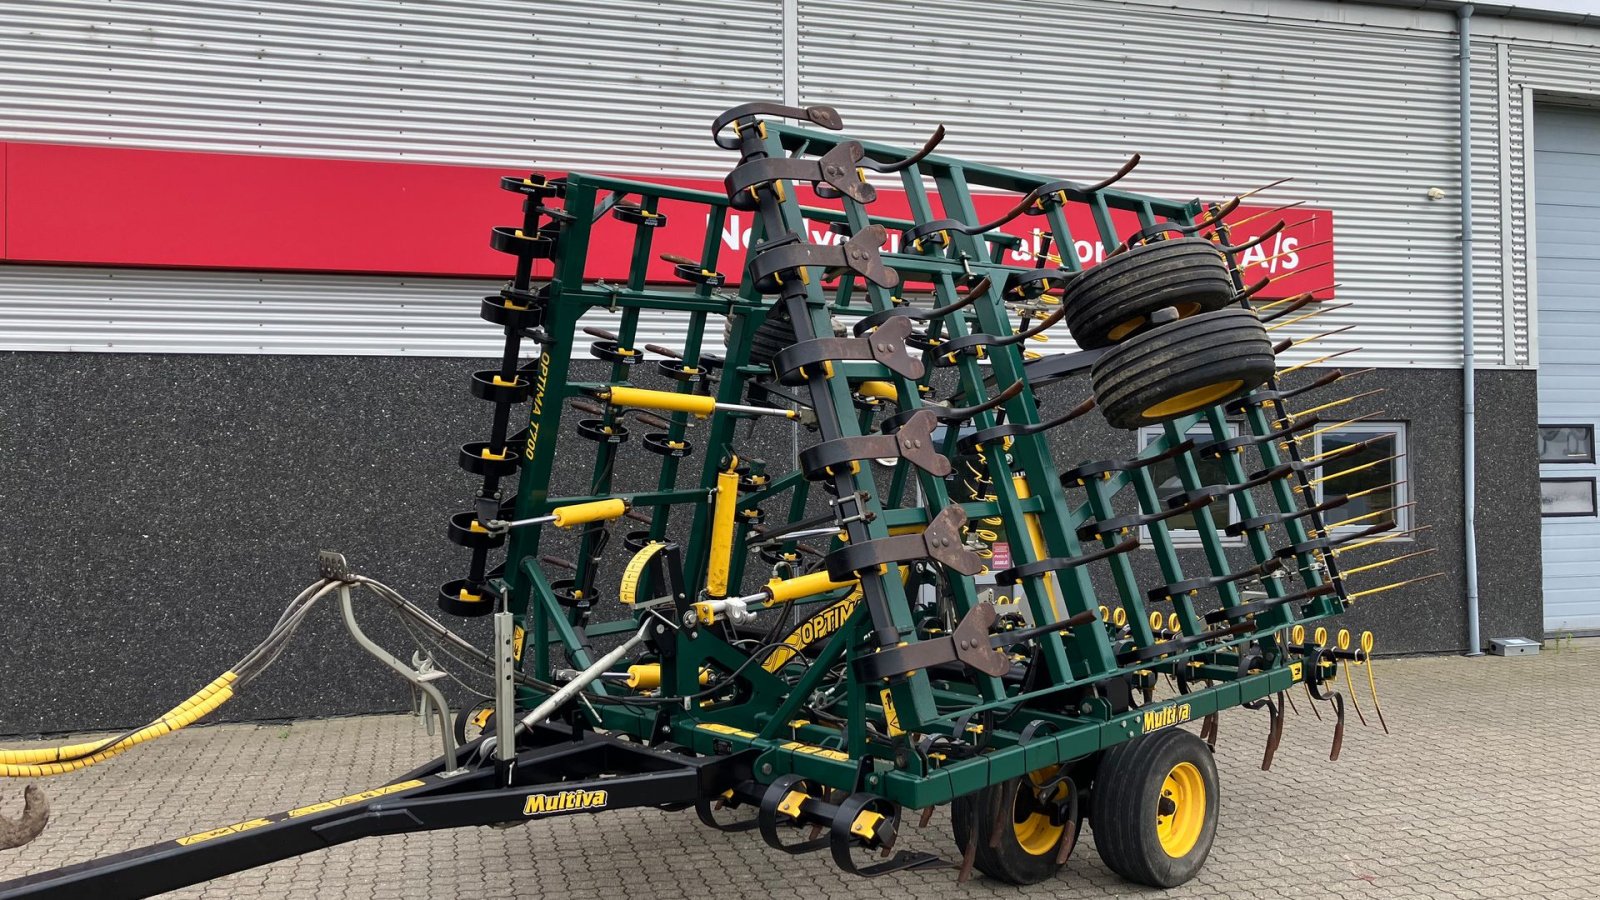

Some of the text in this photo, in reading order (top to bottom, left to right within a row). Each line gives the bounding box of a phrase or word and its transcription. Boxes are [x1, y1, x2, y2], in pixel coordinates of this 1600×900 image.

[1241, 231, 1299, 273] A/S
[525, 351, 550, 460] OPTIMA T700
[800, 597, 861, 645] OPTIM
[524, 790, 607, 815] Multiva
